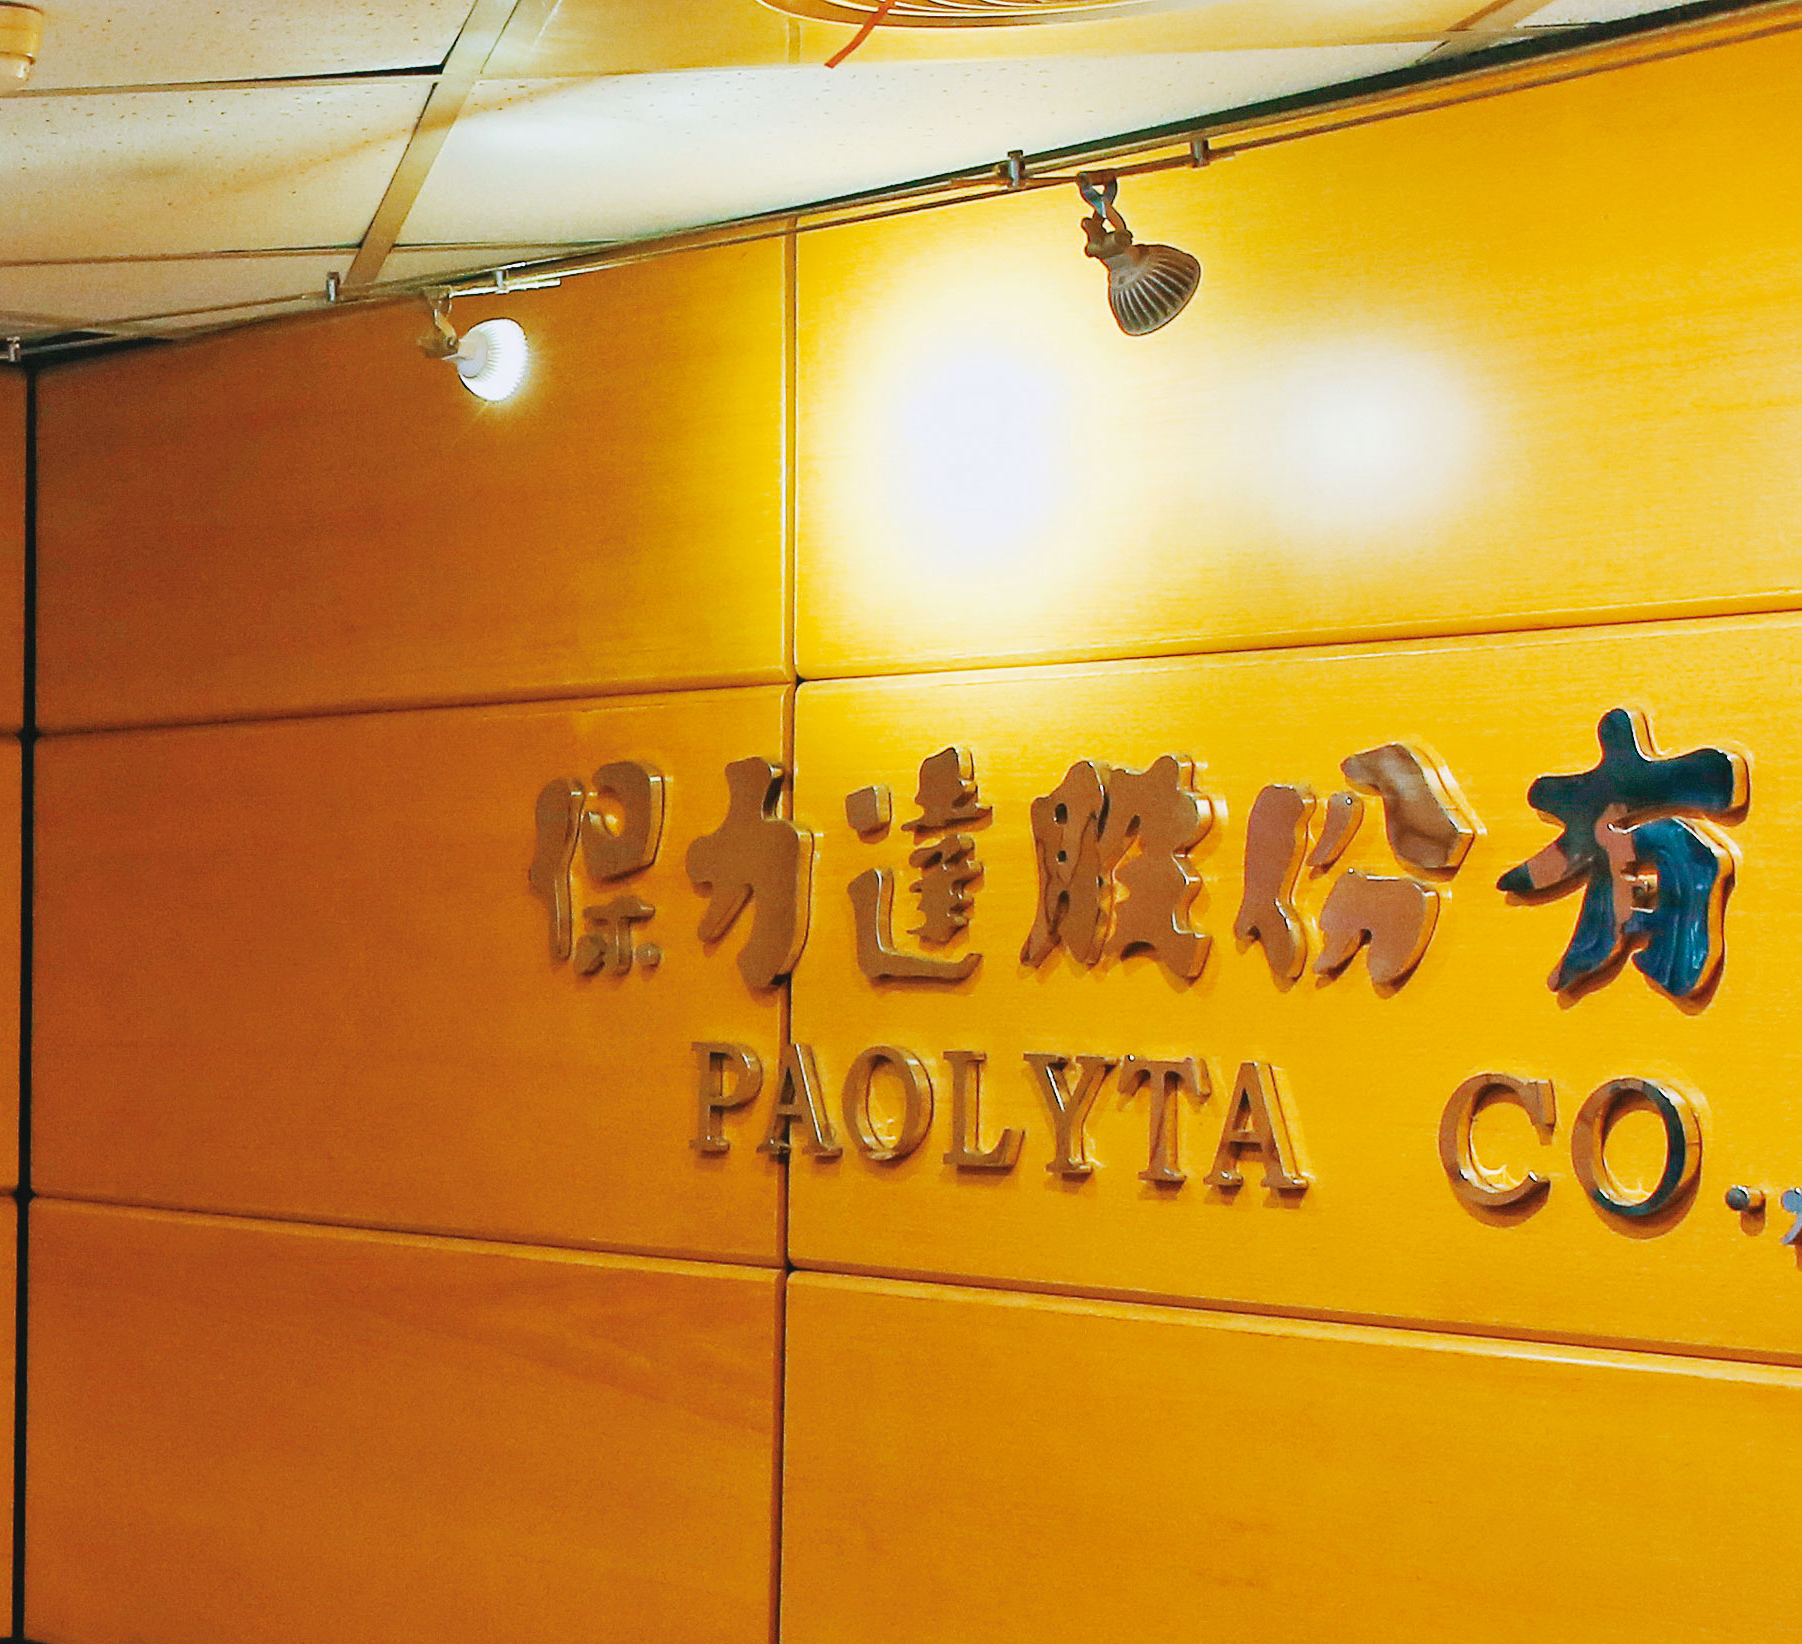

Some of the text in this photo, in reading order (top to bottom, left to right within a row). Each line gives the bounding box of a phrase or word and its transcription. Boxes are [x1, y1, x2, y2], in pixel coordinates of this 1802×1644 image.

[528, 707, 1752, 1000] 保力達股份有
[687, 1040, 1314, 1192] PAOLYTA
